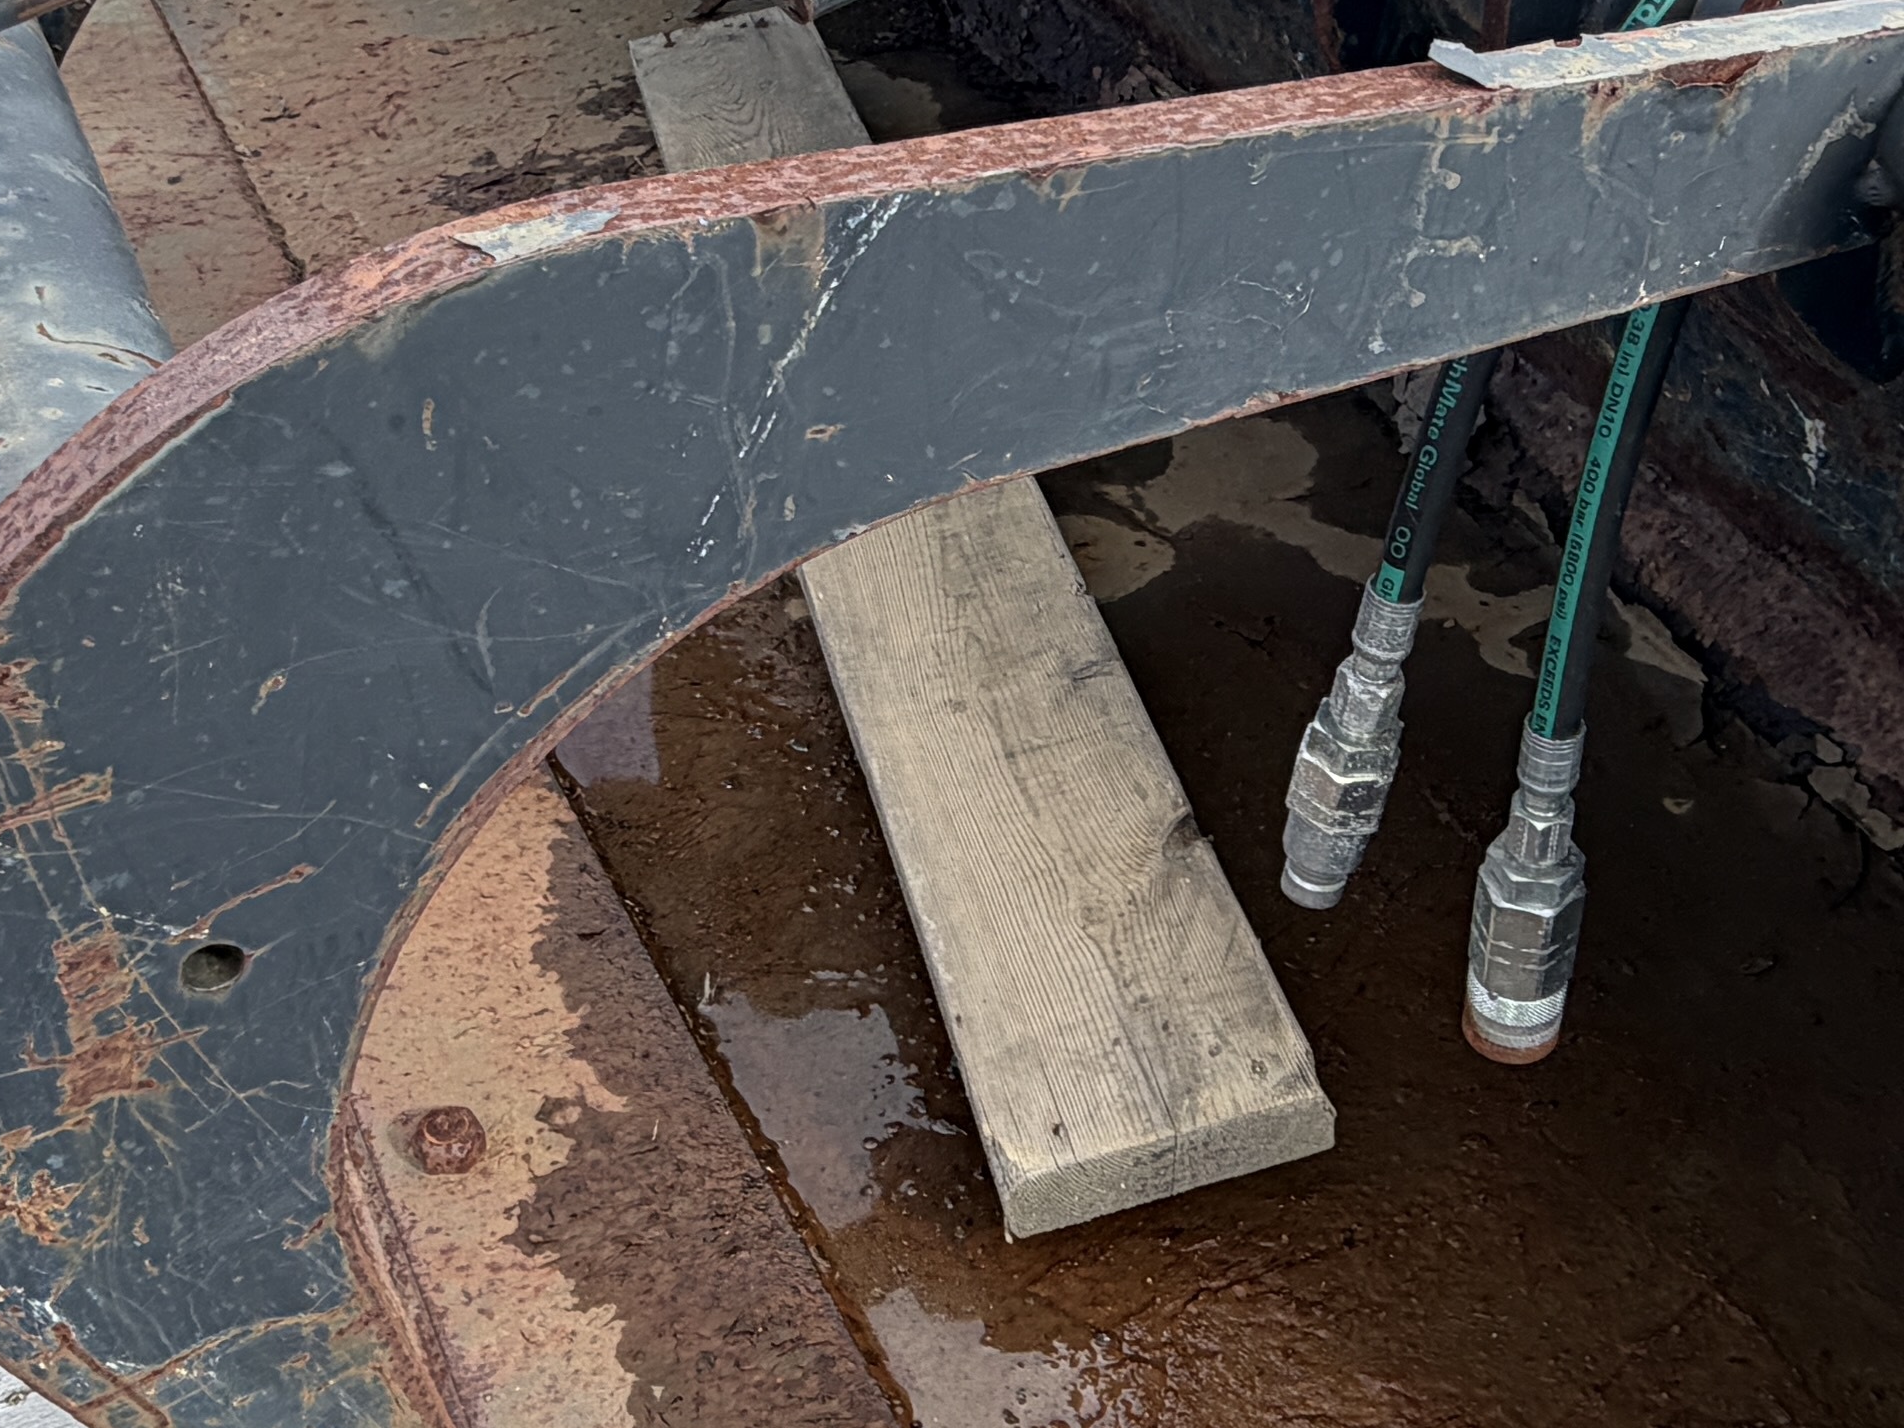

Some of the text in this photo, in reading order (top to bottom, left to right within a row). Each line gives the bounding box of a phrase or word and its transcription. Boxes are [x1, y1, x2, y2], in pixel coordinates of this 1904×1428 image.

[1598, 379, 1625, 439] DN10
[1404, 444, 1438, 510] Global
[1583, 455, 1602, 495] 400
[1574, 496, 1592, 529] bar
